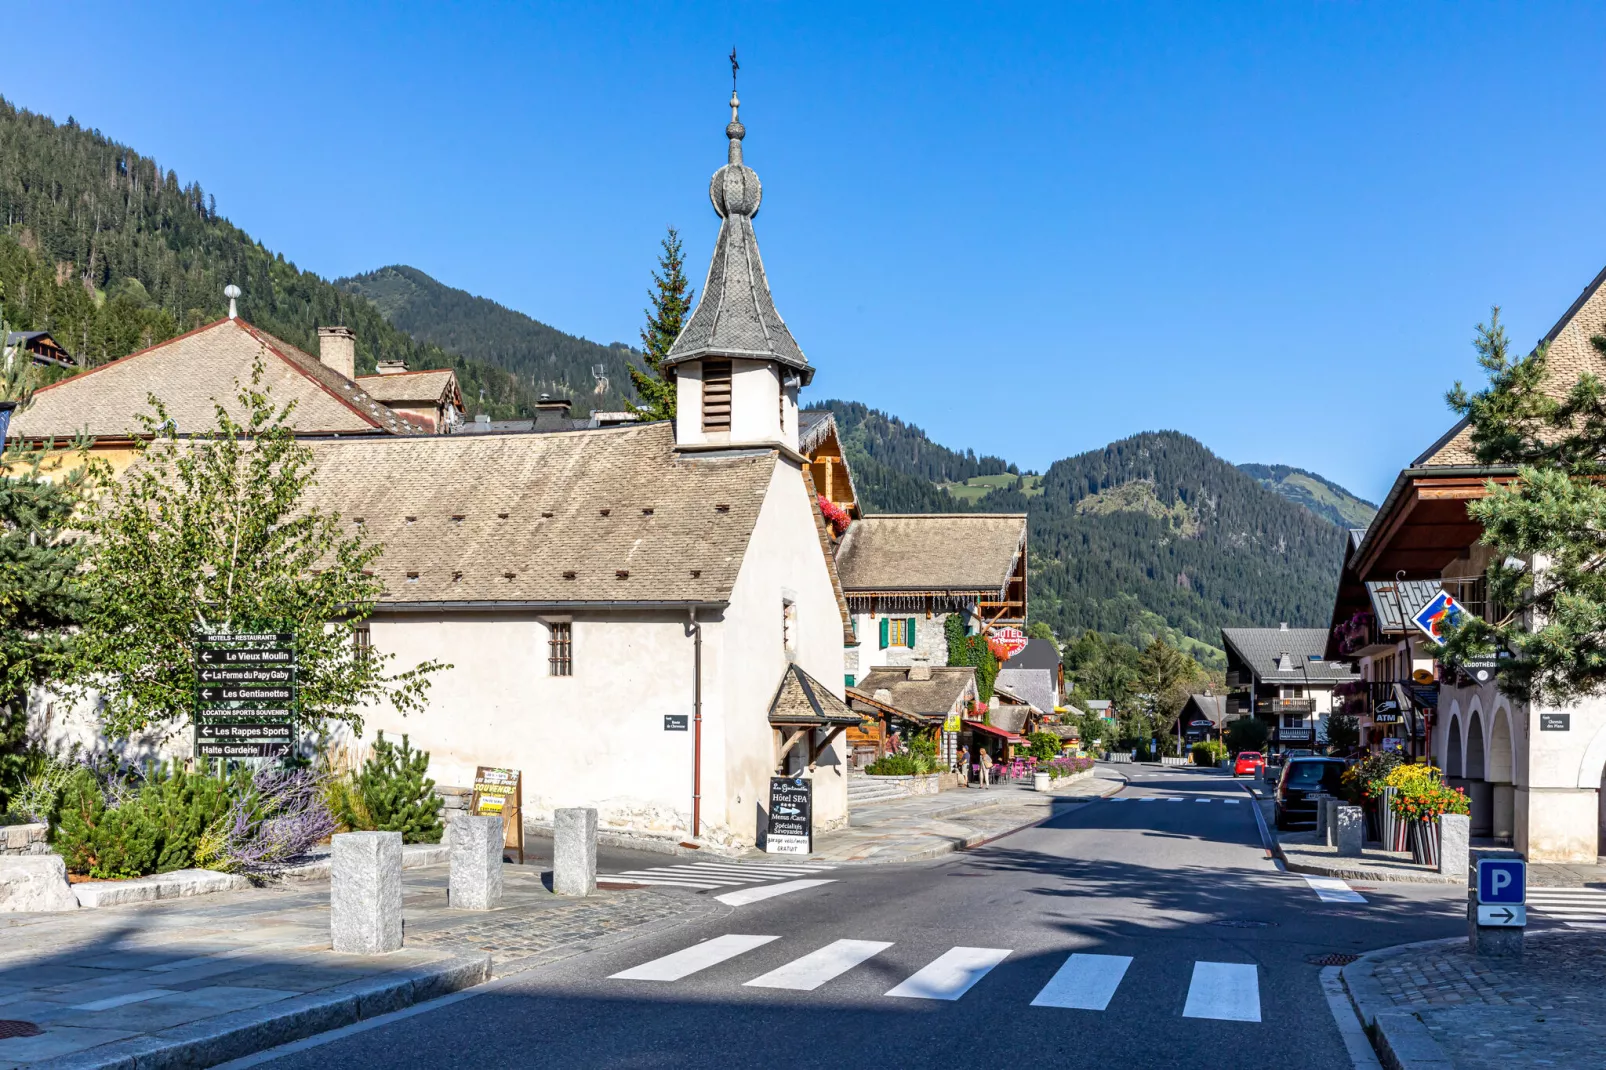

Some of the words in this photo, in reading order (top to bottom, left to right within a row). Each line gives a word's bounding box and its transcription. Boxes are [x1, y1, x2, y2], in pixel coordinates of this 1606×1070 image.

[993, 628, 1022, 638] HOTEL
[262, 652, 289, 660] Moulin
[253, 671, 270, 680] Papy
[271, 671, 289, 680] Gaby
[232, 727, 261, 737] Rappes
[262, 727, 289, 737] Sports
[224, 746, 258, 754] Garderie
[474, 784, 516, 794] SOUVENIRS
[772, 794, 792, 802] Hôtel
[1492, 869, 1512, 895] P
